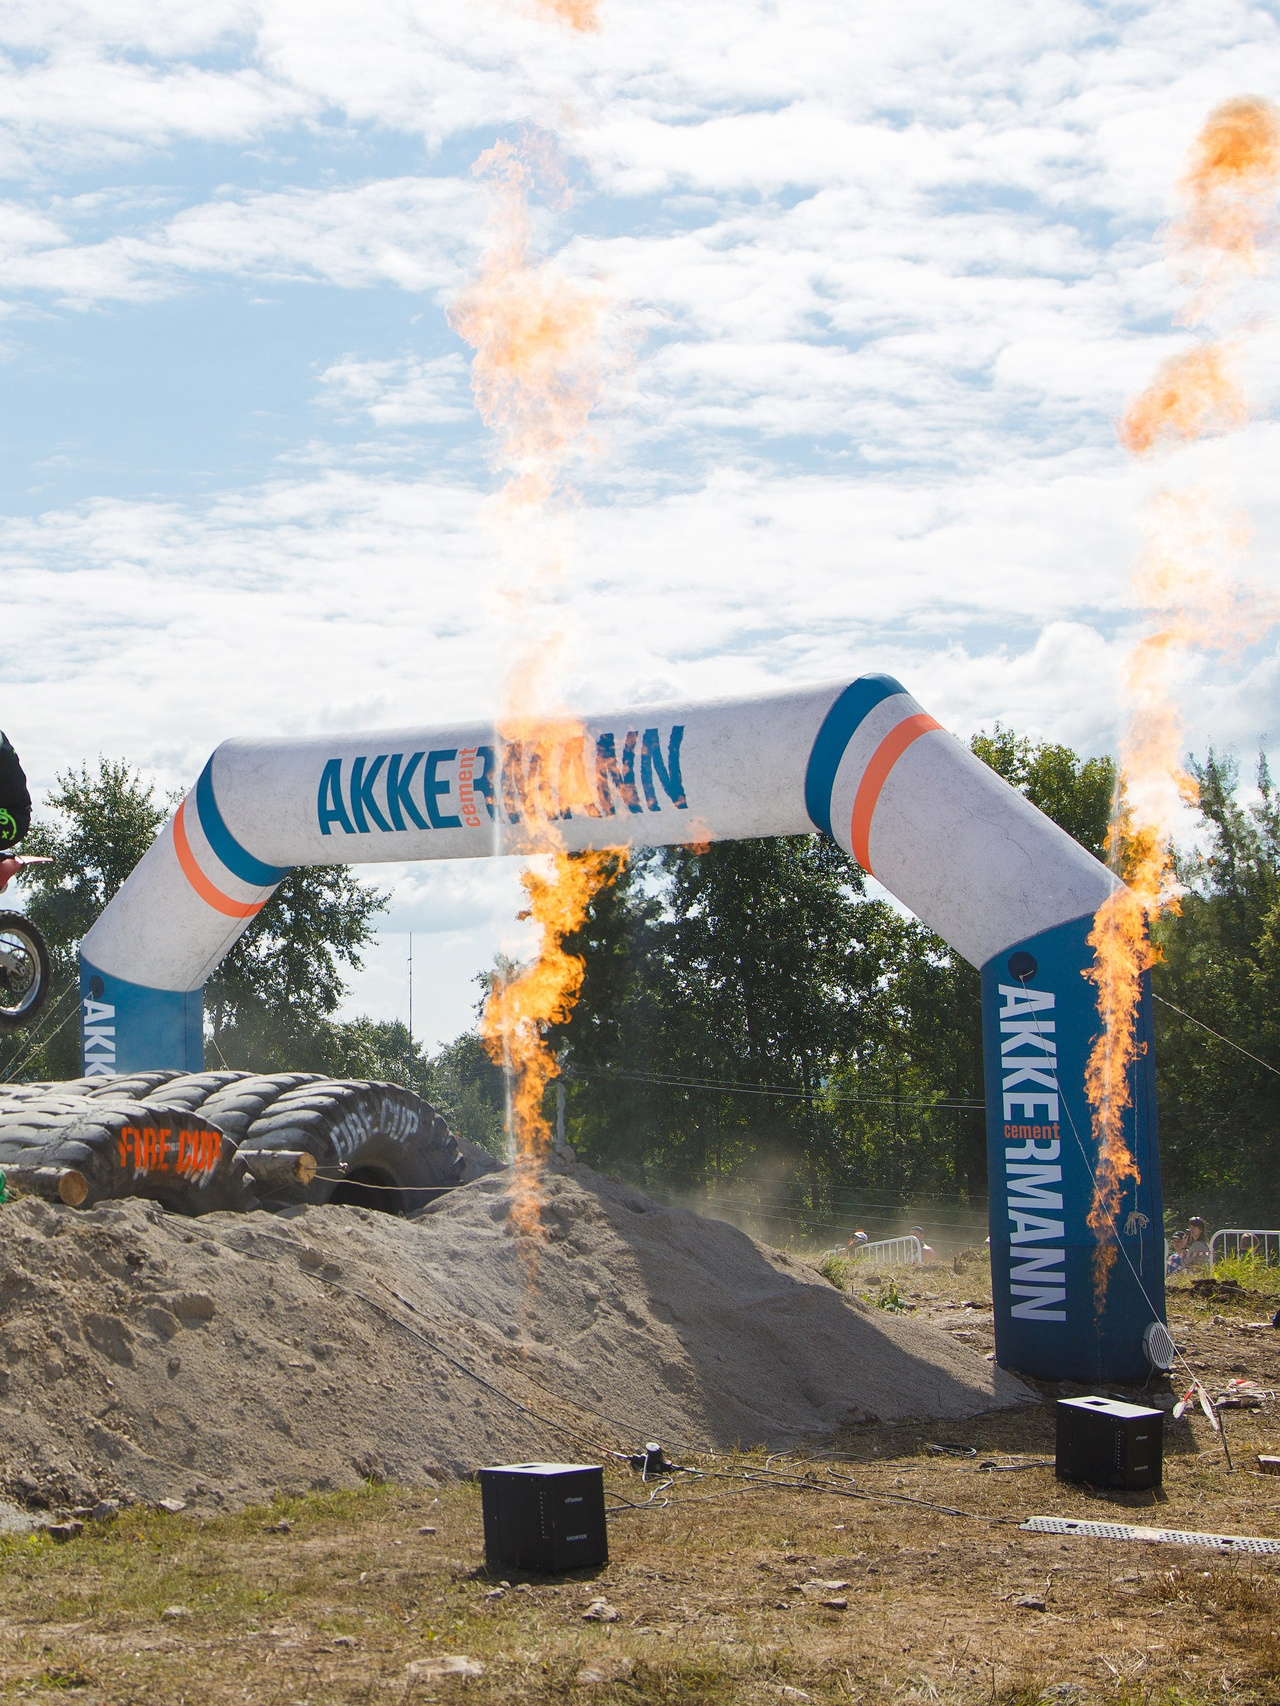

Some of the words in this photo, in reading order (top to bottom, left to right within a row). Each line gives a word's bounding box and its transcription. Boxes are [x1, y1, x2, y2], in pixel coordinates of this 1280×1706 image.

[459, 746, 482, 828] cement
[118, 1126, 172, 1171] FIRE
[176, 1129, 222, 1174] CUP
[330, 1101, 380, 1162] FIRE
[380, 1098, 419, 1143] CUP
[998, 983, 1067, 1322] AKKERMANN
[1003, 1121, 1060, 1140] cement
